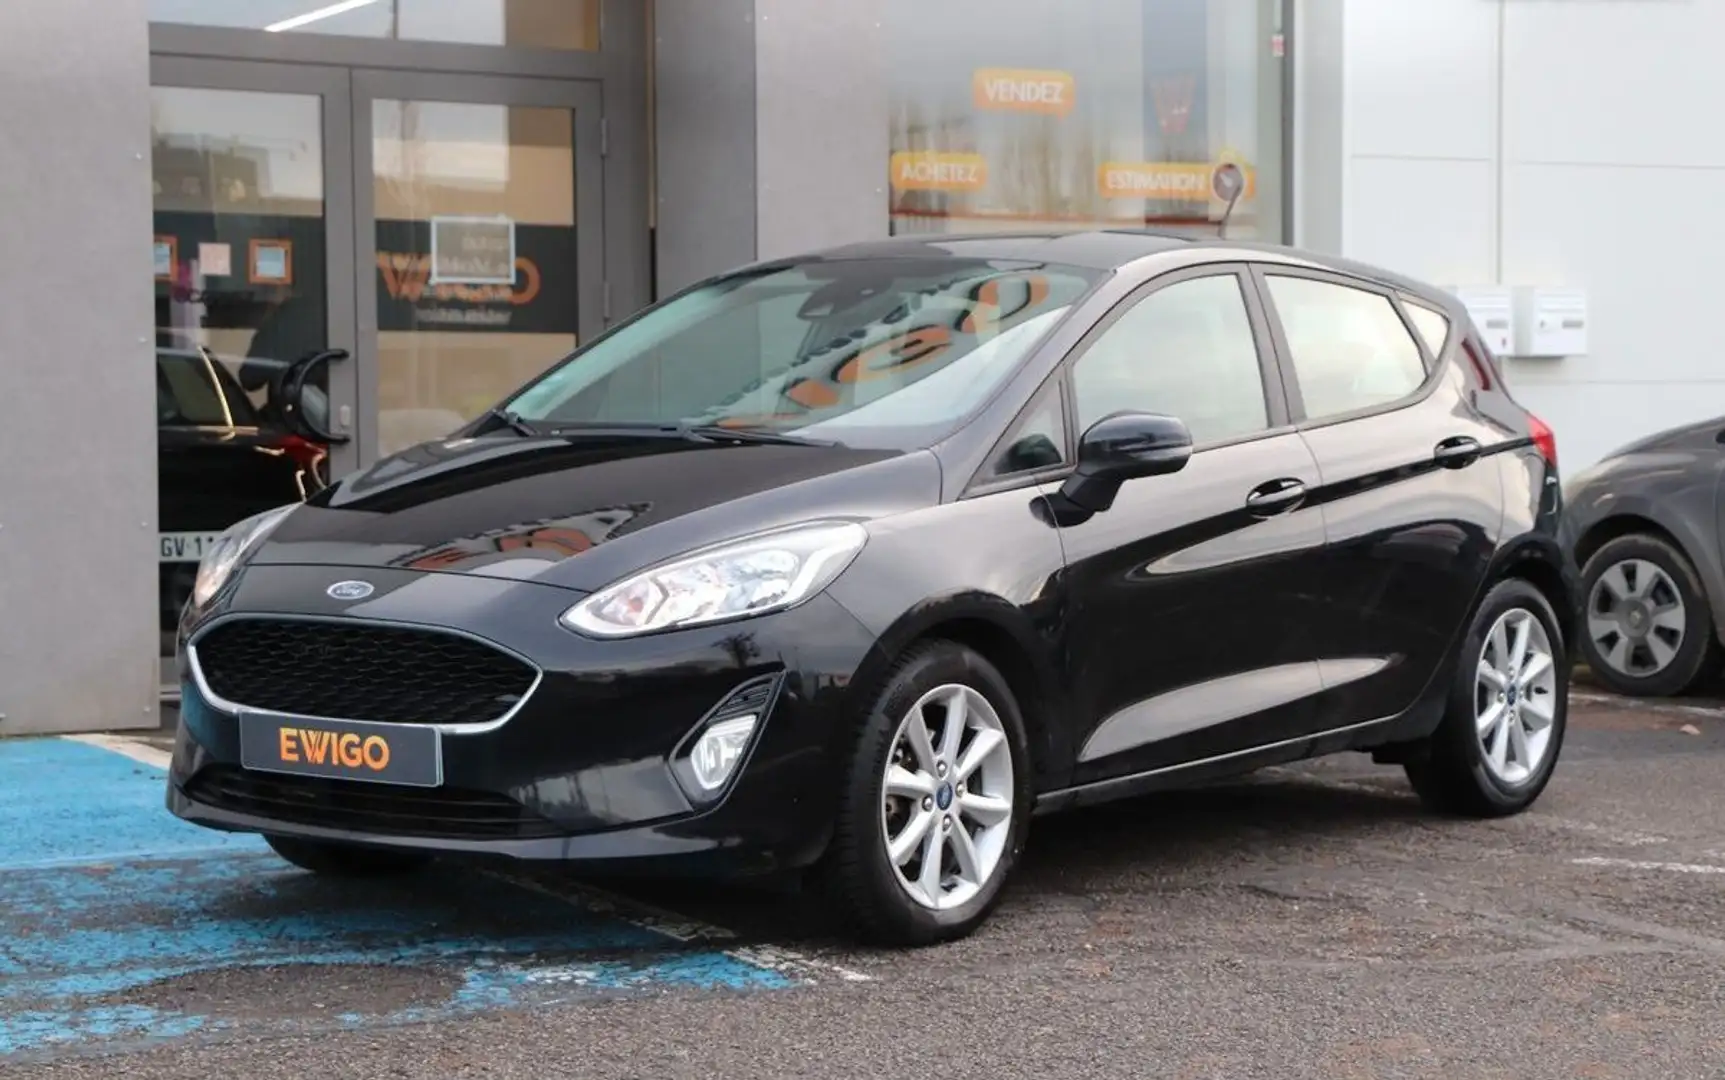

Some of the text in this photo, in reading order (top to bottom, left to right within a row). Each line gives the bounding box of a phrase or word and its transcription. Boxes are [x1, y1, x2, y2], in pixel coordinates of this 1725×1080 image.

[985, 79, 1065, 104] VENDEZ
[902, 162, 978, 183] ACHETEZ
[279, 727, 390, 771] EWIGO
